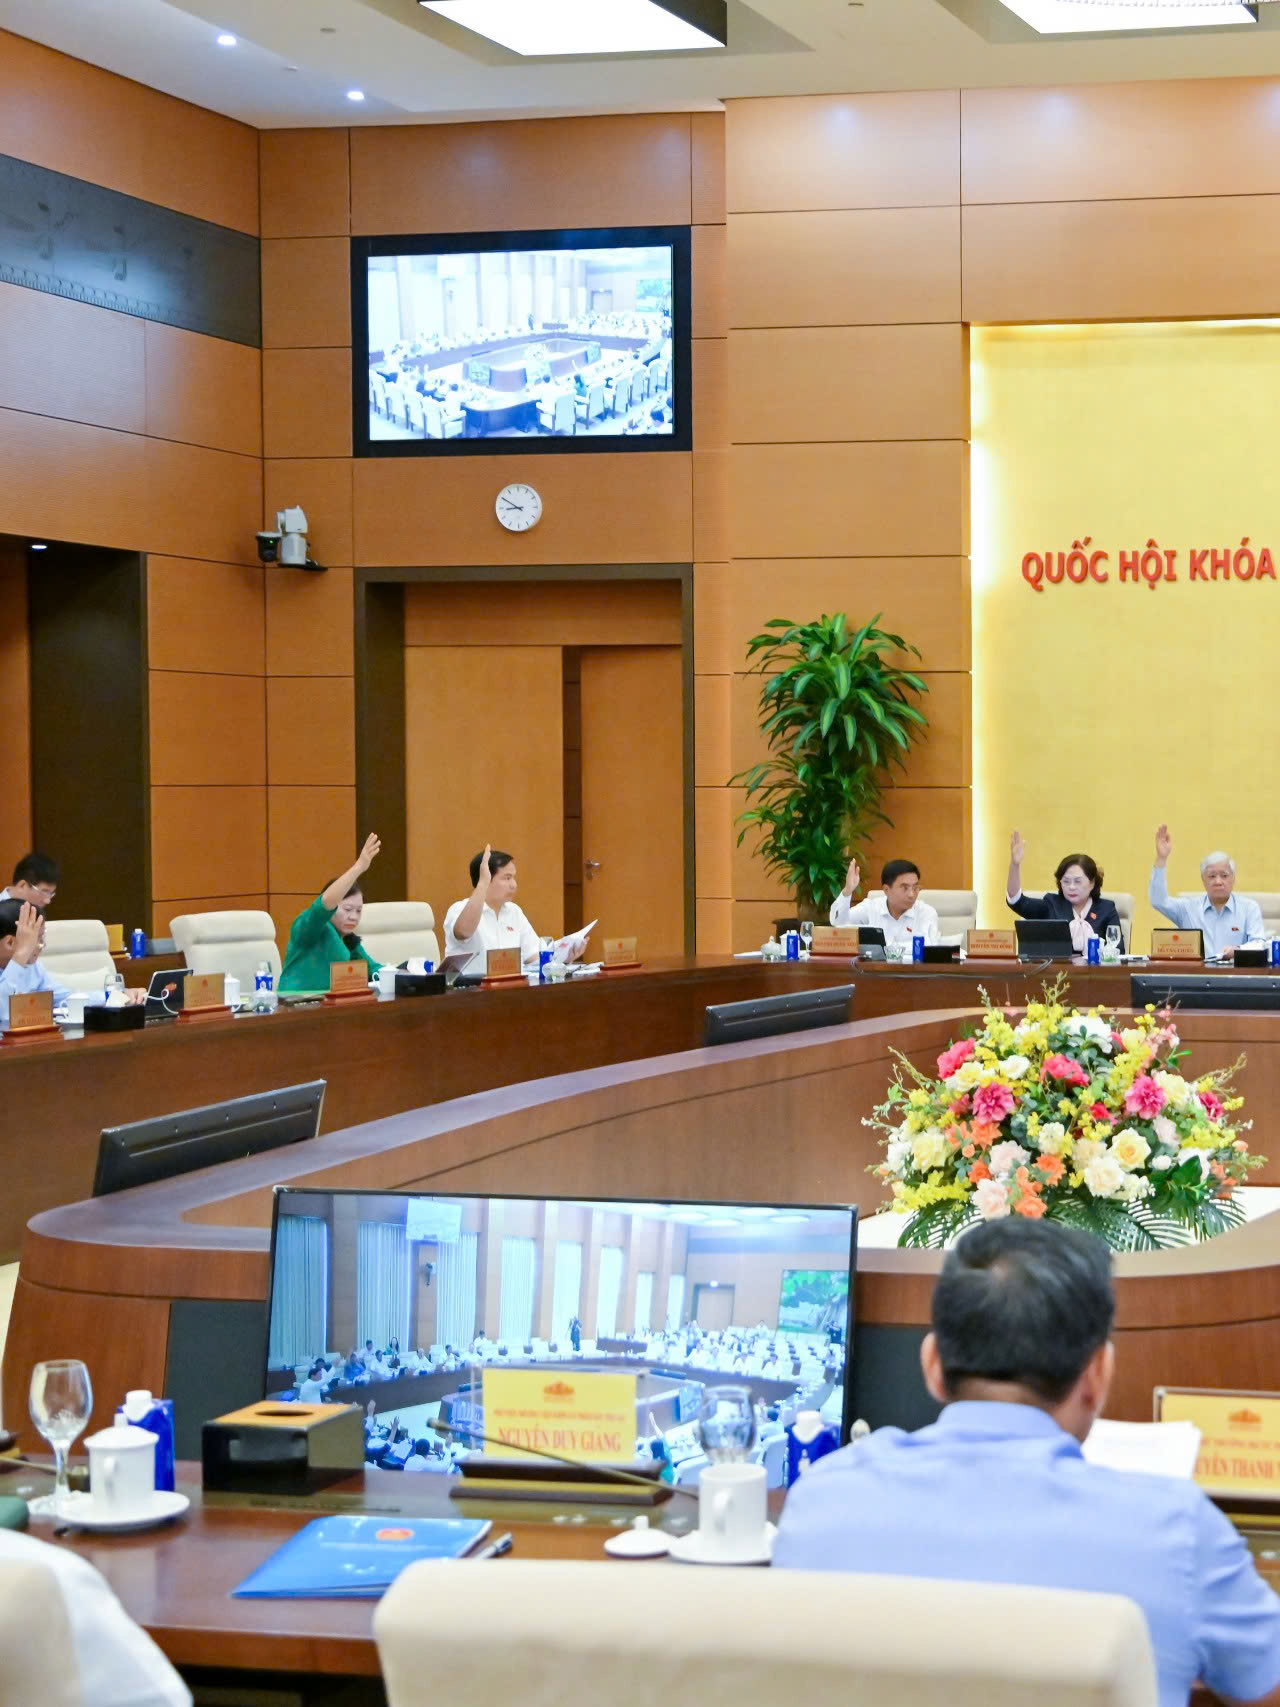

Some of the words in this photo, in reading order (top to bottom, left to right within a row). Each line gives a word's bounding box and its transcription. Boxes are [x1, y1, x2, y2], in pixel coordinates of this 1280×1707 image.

[1022, 536, 1109, 592] QUỐC
[1119, 538, 1177, 590] HỘI
[1189, 536, 1276, 581] KHÓA
